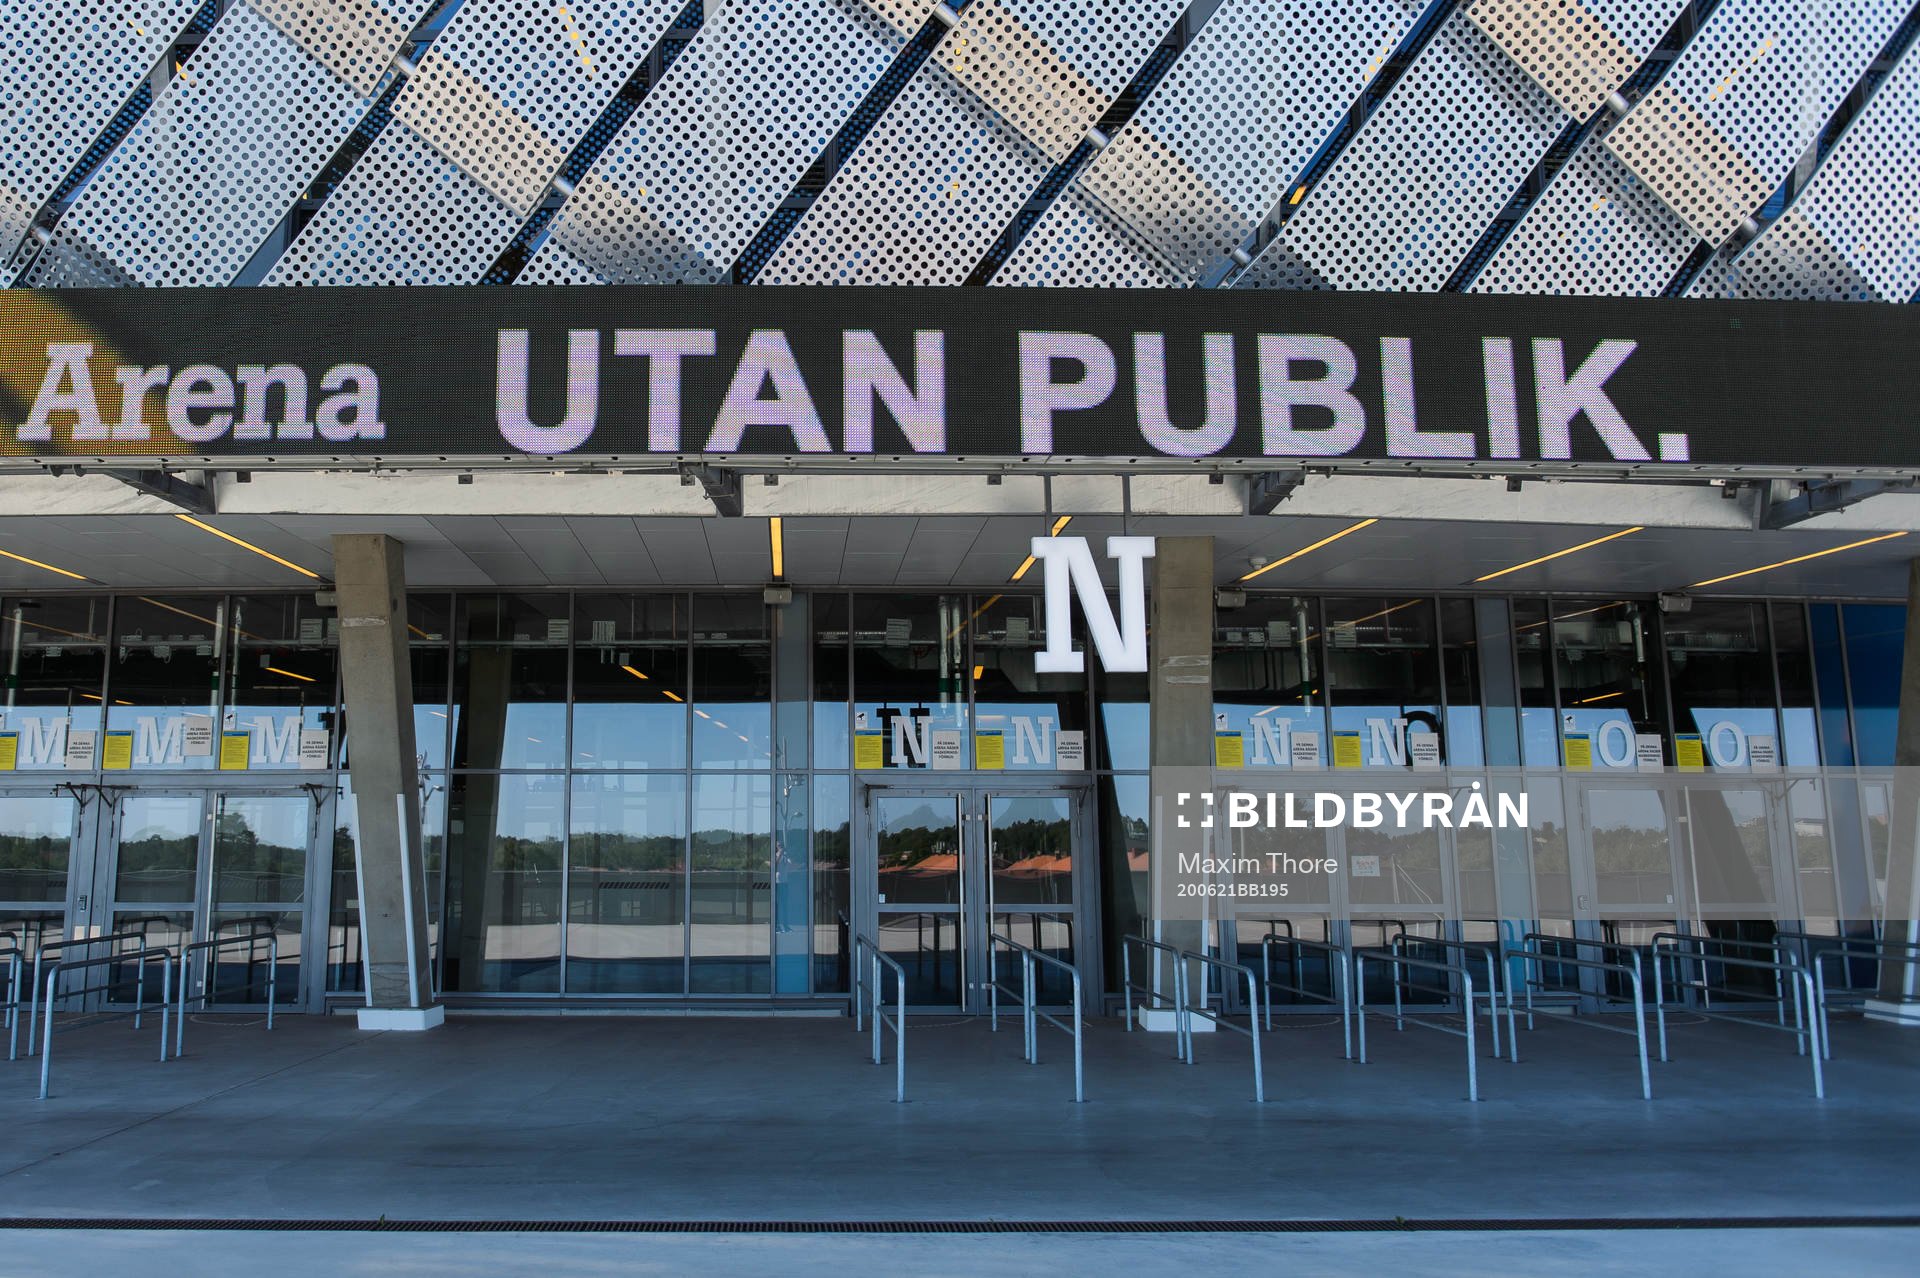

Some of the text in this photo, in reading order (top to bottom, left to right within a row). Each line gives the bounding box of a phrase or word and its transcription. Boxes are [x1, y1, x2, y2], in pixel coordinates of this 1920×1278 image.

[15, 341, 387, 442] Arena
[495, 328, 1691, 461] UTAN PUBLIK.
[1030, 535, 1156, 673] N
[19, 717, 67, 764] M
[134, 716, 185, 764] M
[252, 716, 302, 764] M
[891, 716, 934, 764] N
[1012, 716, 1054, 764] N
[1250, 717, 1292, 765] N
[1365, 718, 1408, 766] N
[1598, 720, 1636, 768] O
[1709, 720, 1746, 768] O
